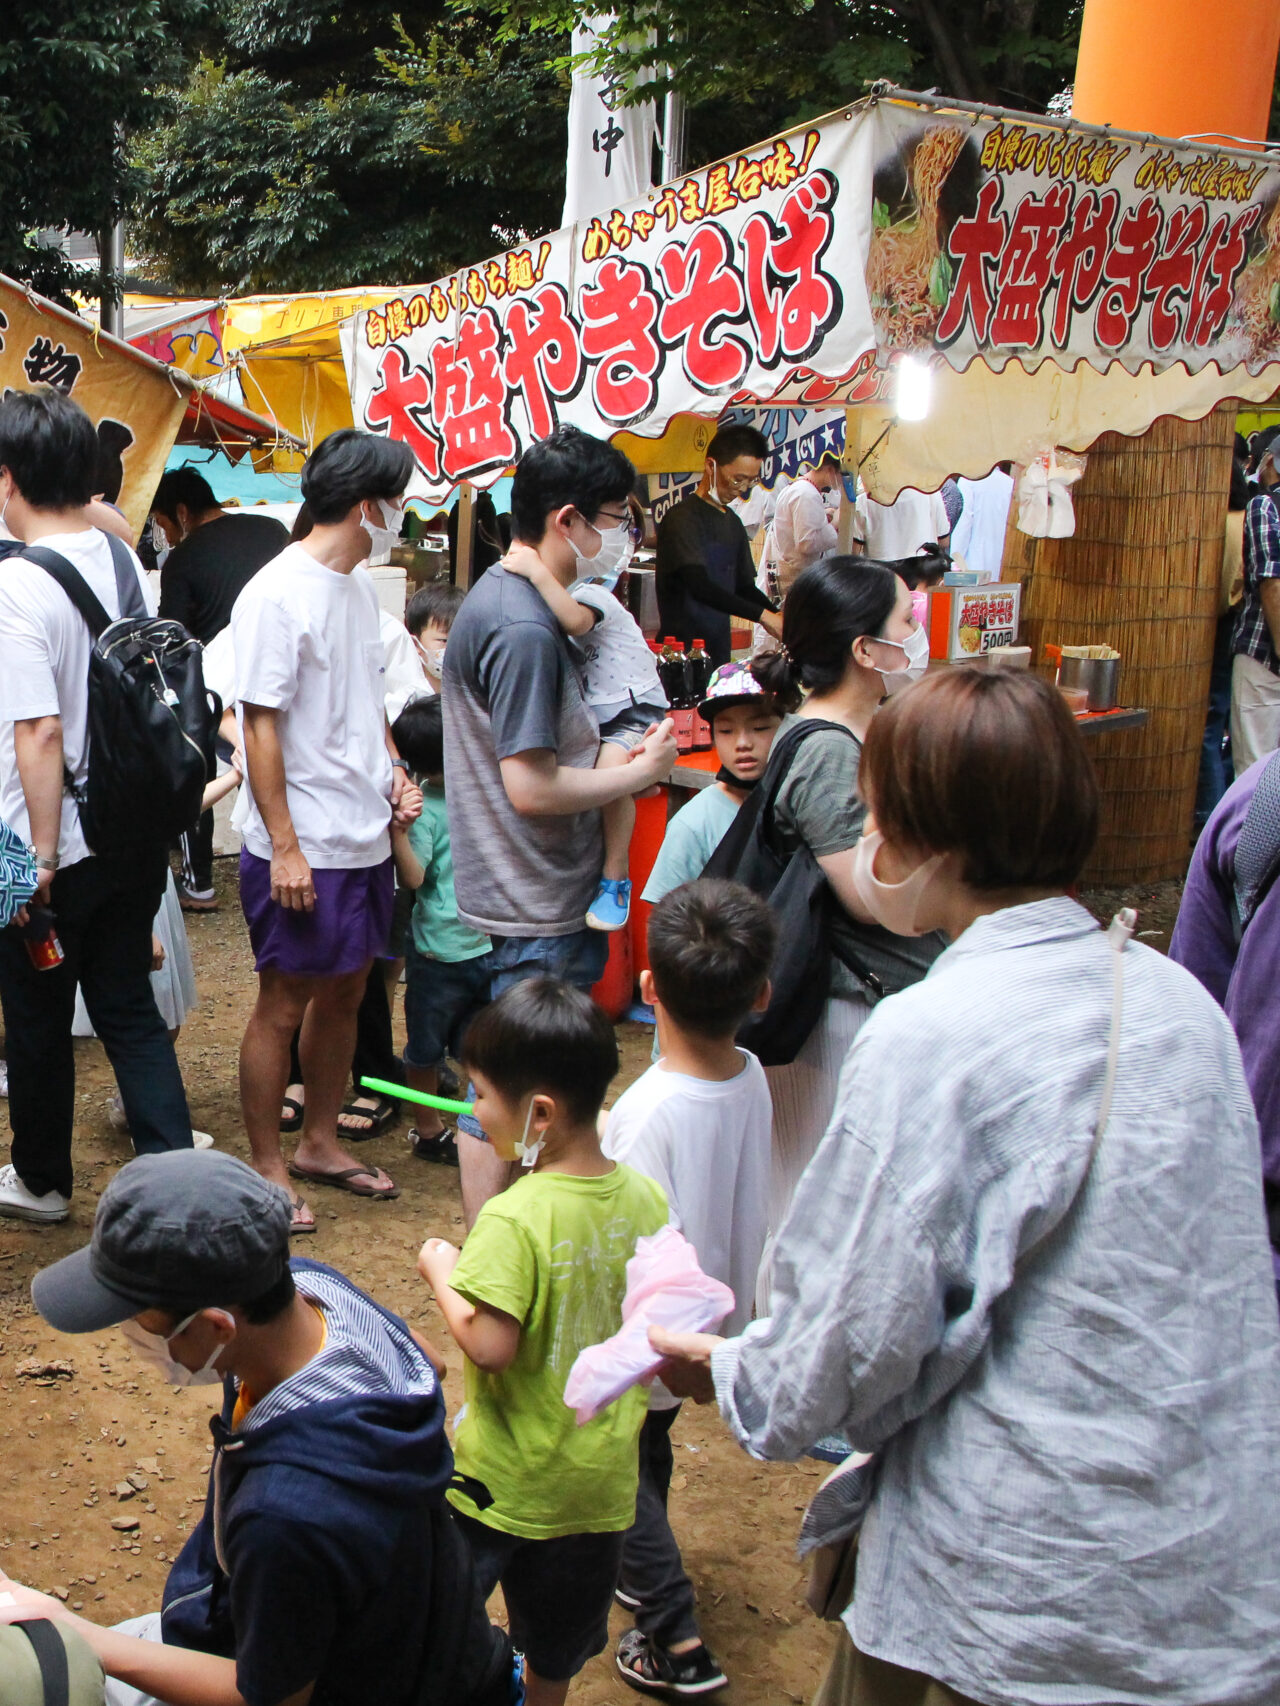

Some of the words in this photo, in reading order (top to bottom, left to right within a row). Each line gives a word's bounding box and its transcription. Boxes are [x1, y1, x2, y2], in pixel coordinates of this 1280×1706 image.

[582, 129, 821, 264] めちゃうま屋台味!
[980, 122, 1132, 187] 自慢のもちもち麺!
[365, 240, 552, 349] 自慢のもちもち麺!
[933, 172, 1264, 352] 大盛やきそば
[364, 167, 843, 487] 大盛やきそば
[795, 433, 817, 462] Icy
[961, 598, 1014, 627] 大盛やきそば
